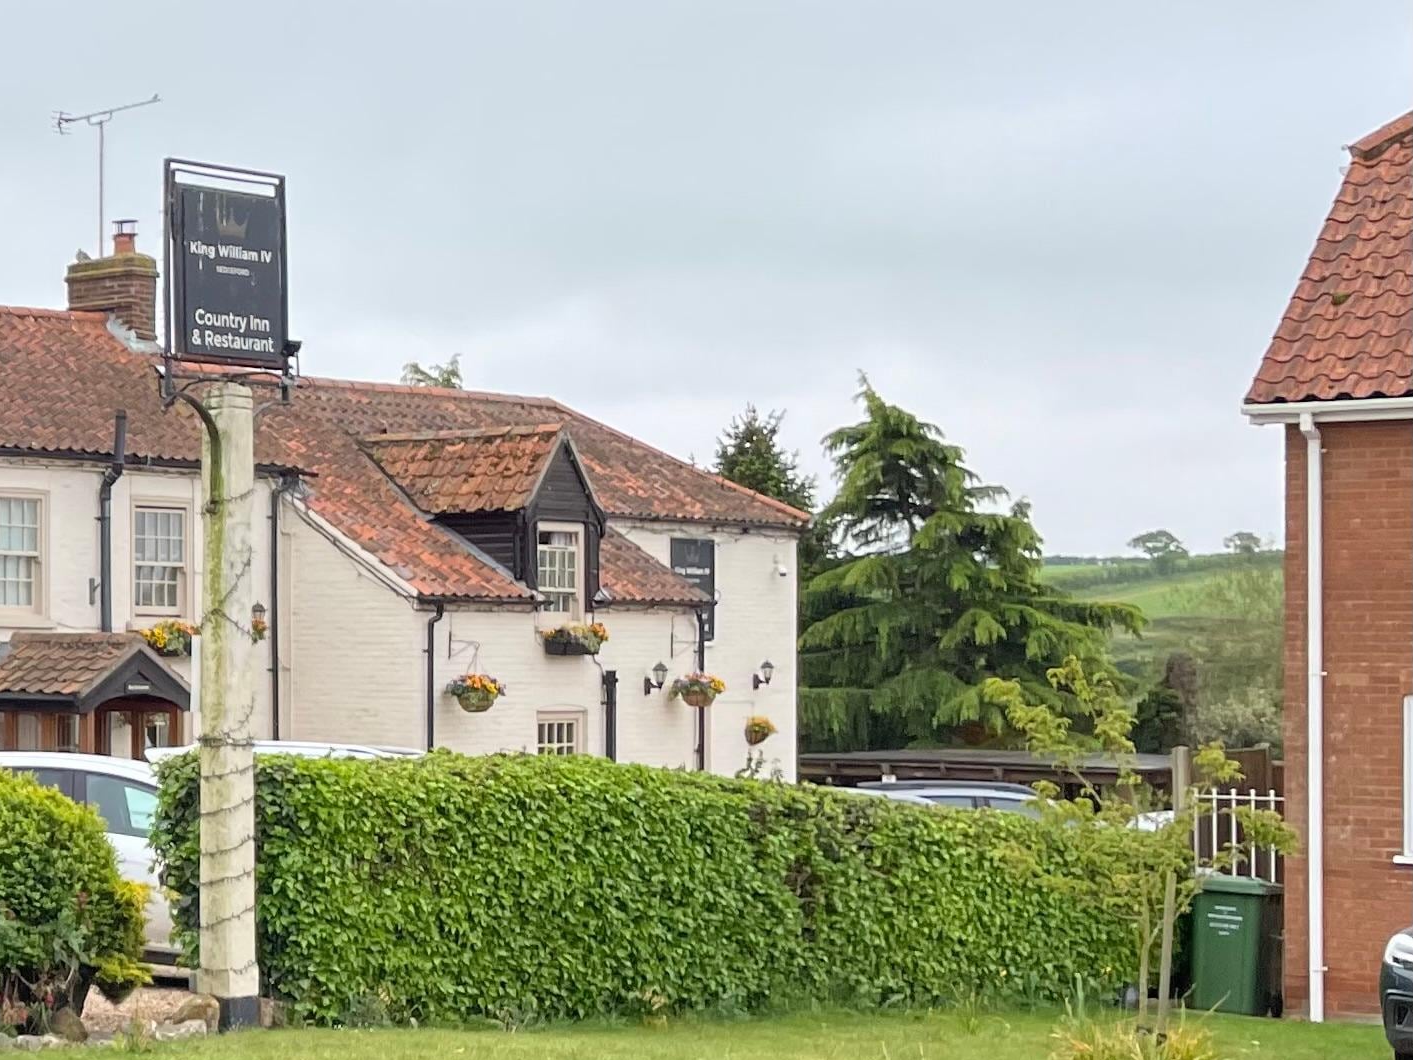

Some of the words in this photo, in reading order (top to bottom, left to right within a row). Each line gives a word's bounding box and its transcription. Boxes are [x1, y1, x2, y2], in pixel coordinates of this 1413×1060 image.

[190, 240, 216, 259] King
[218, 244, 259, 262] William
[261, 250, 272, 264] IV
[195, 308, 248, 333] Country
[250, 315, 270, 332] Inn
[192, 329, 201, 345] &
[204, 330, 274, 352] Restaurant
